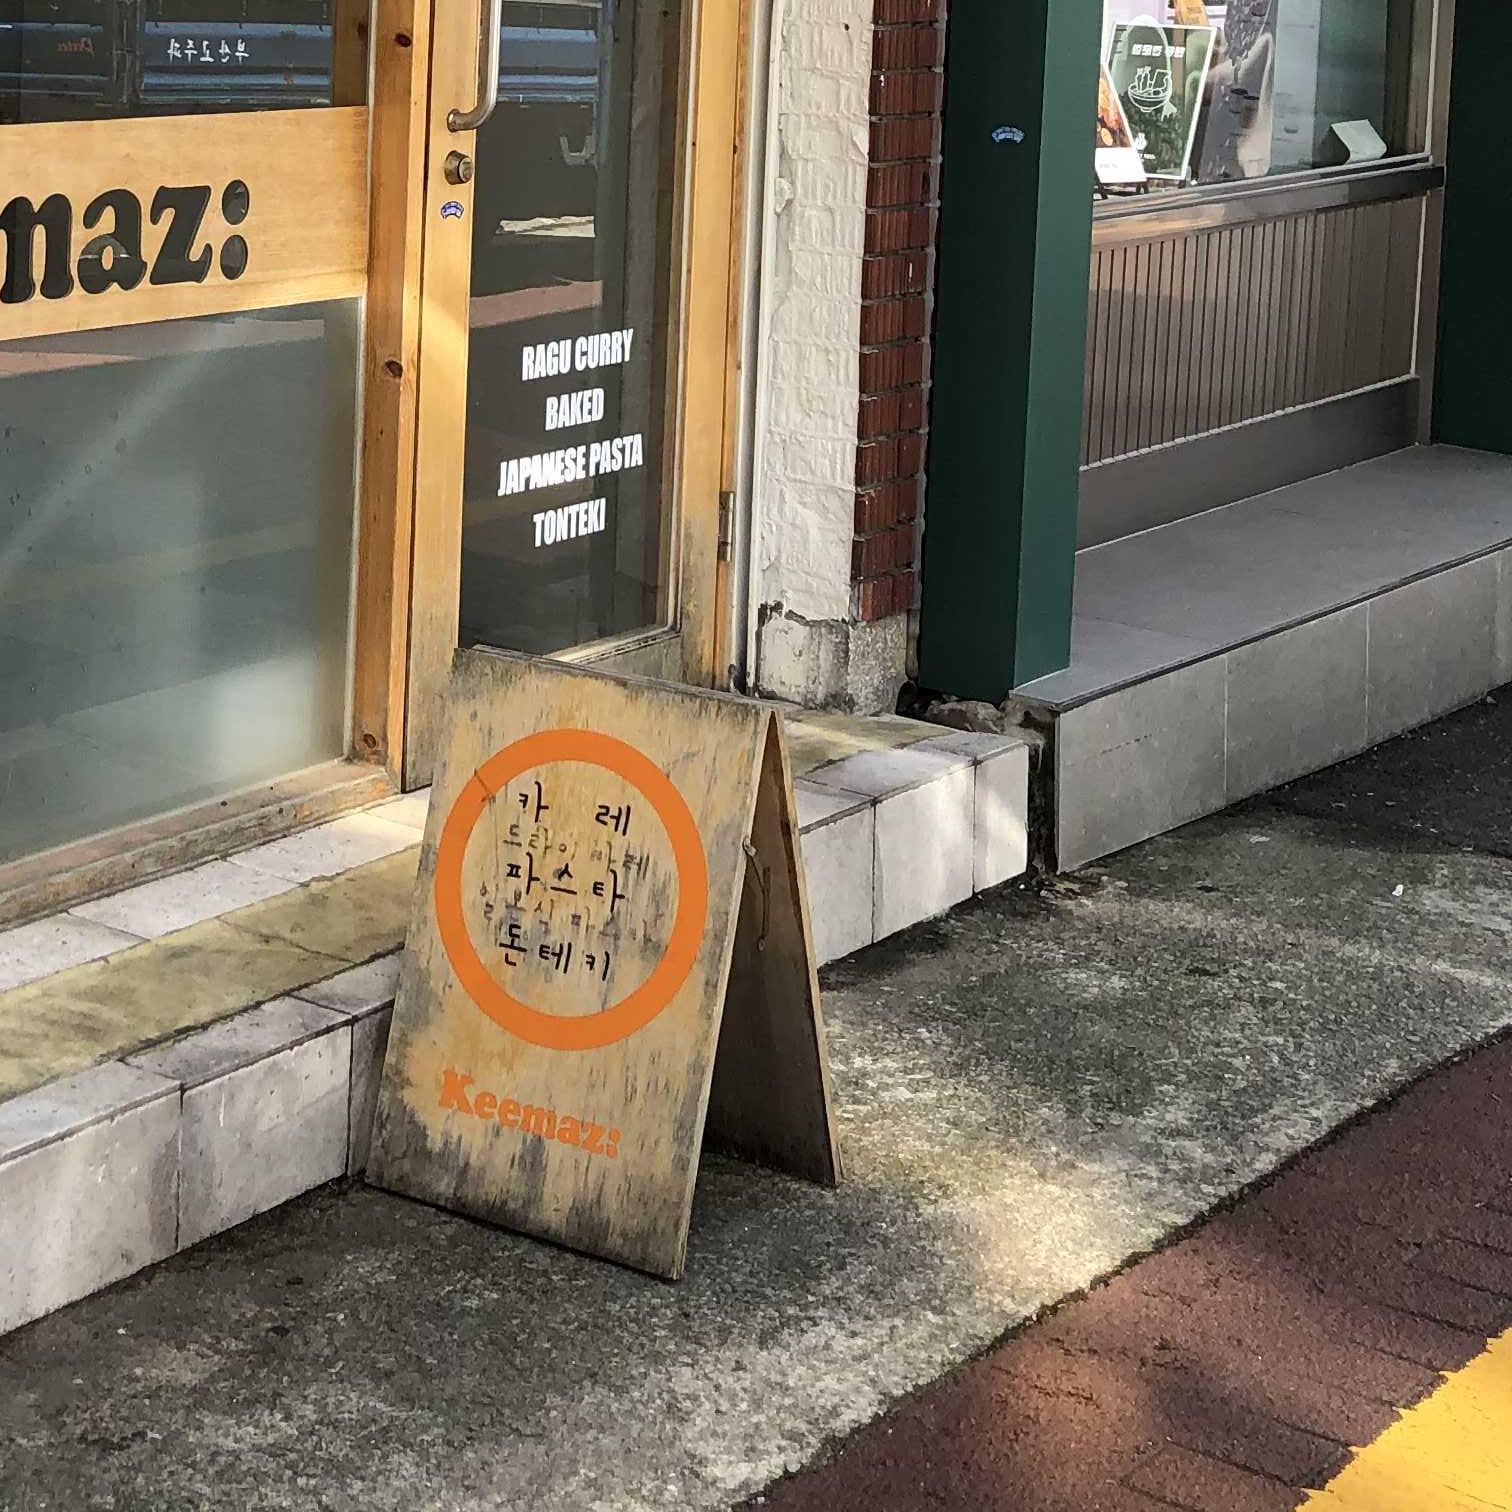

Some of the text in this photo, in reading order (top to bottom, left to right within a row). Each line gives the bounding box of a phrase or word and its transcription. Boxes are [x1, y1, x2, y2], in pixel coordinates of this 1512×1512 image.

[521, 328, 634, 381] RAGU CURRY
[544, 388, 605, 431] BAKED
[497, 433, 644, 496] JAPANESE PASTA
[533, 497, 606, 548] TONTEKI
[506, 852, 625, 913] 파스타
[498, 922, 611, 982] 돈테키
